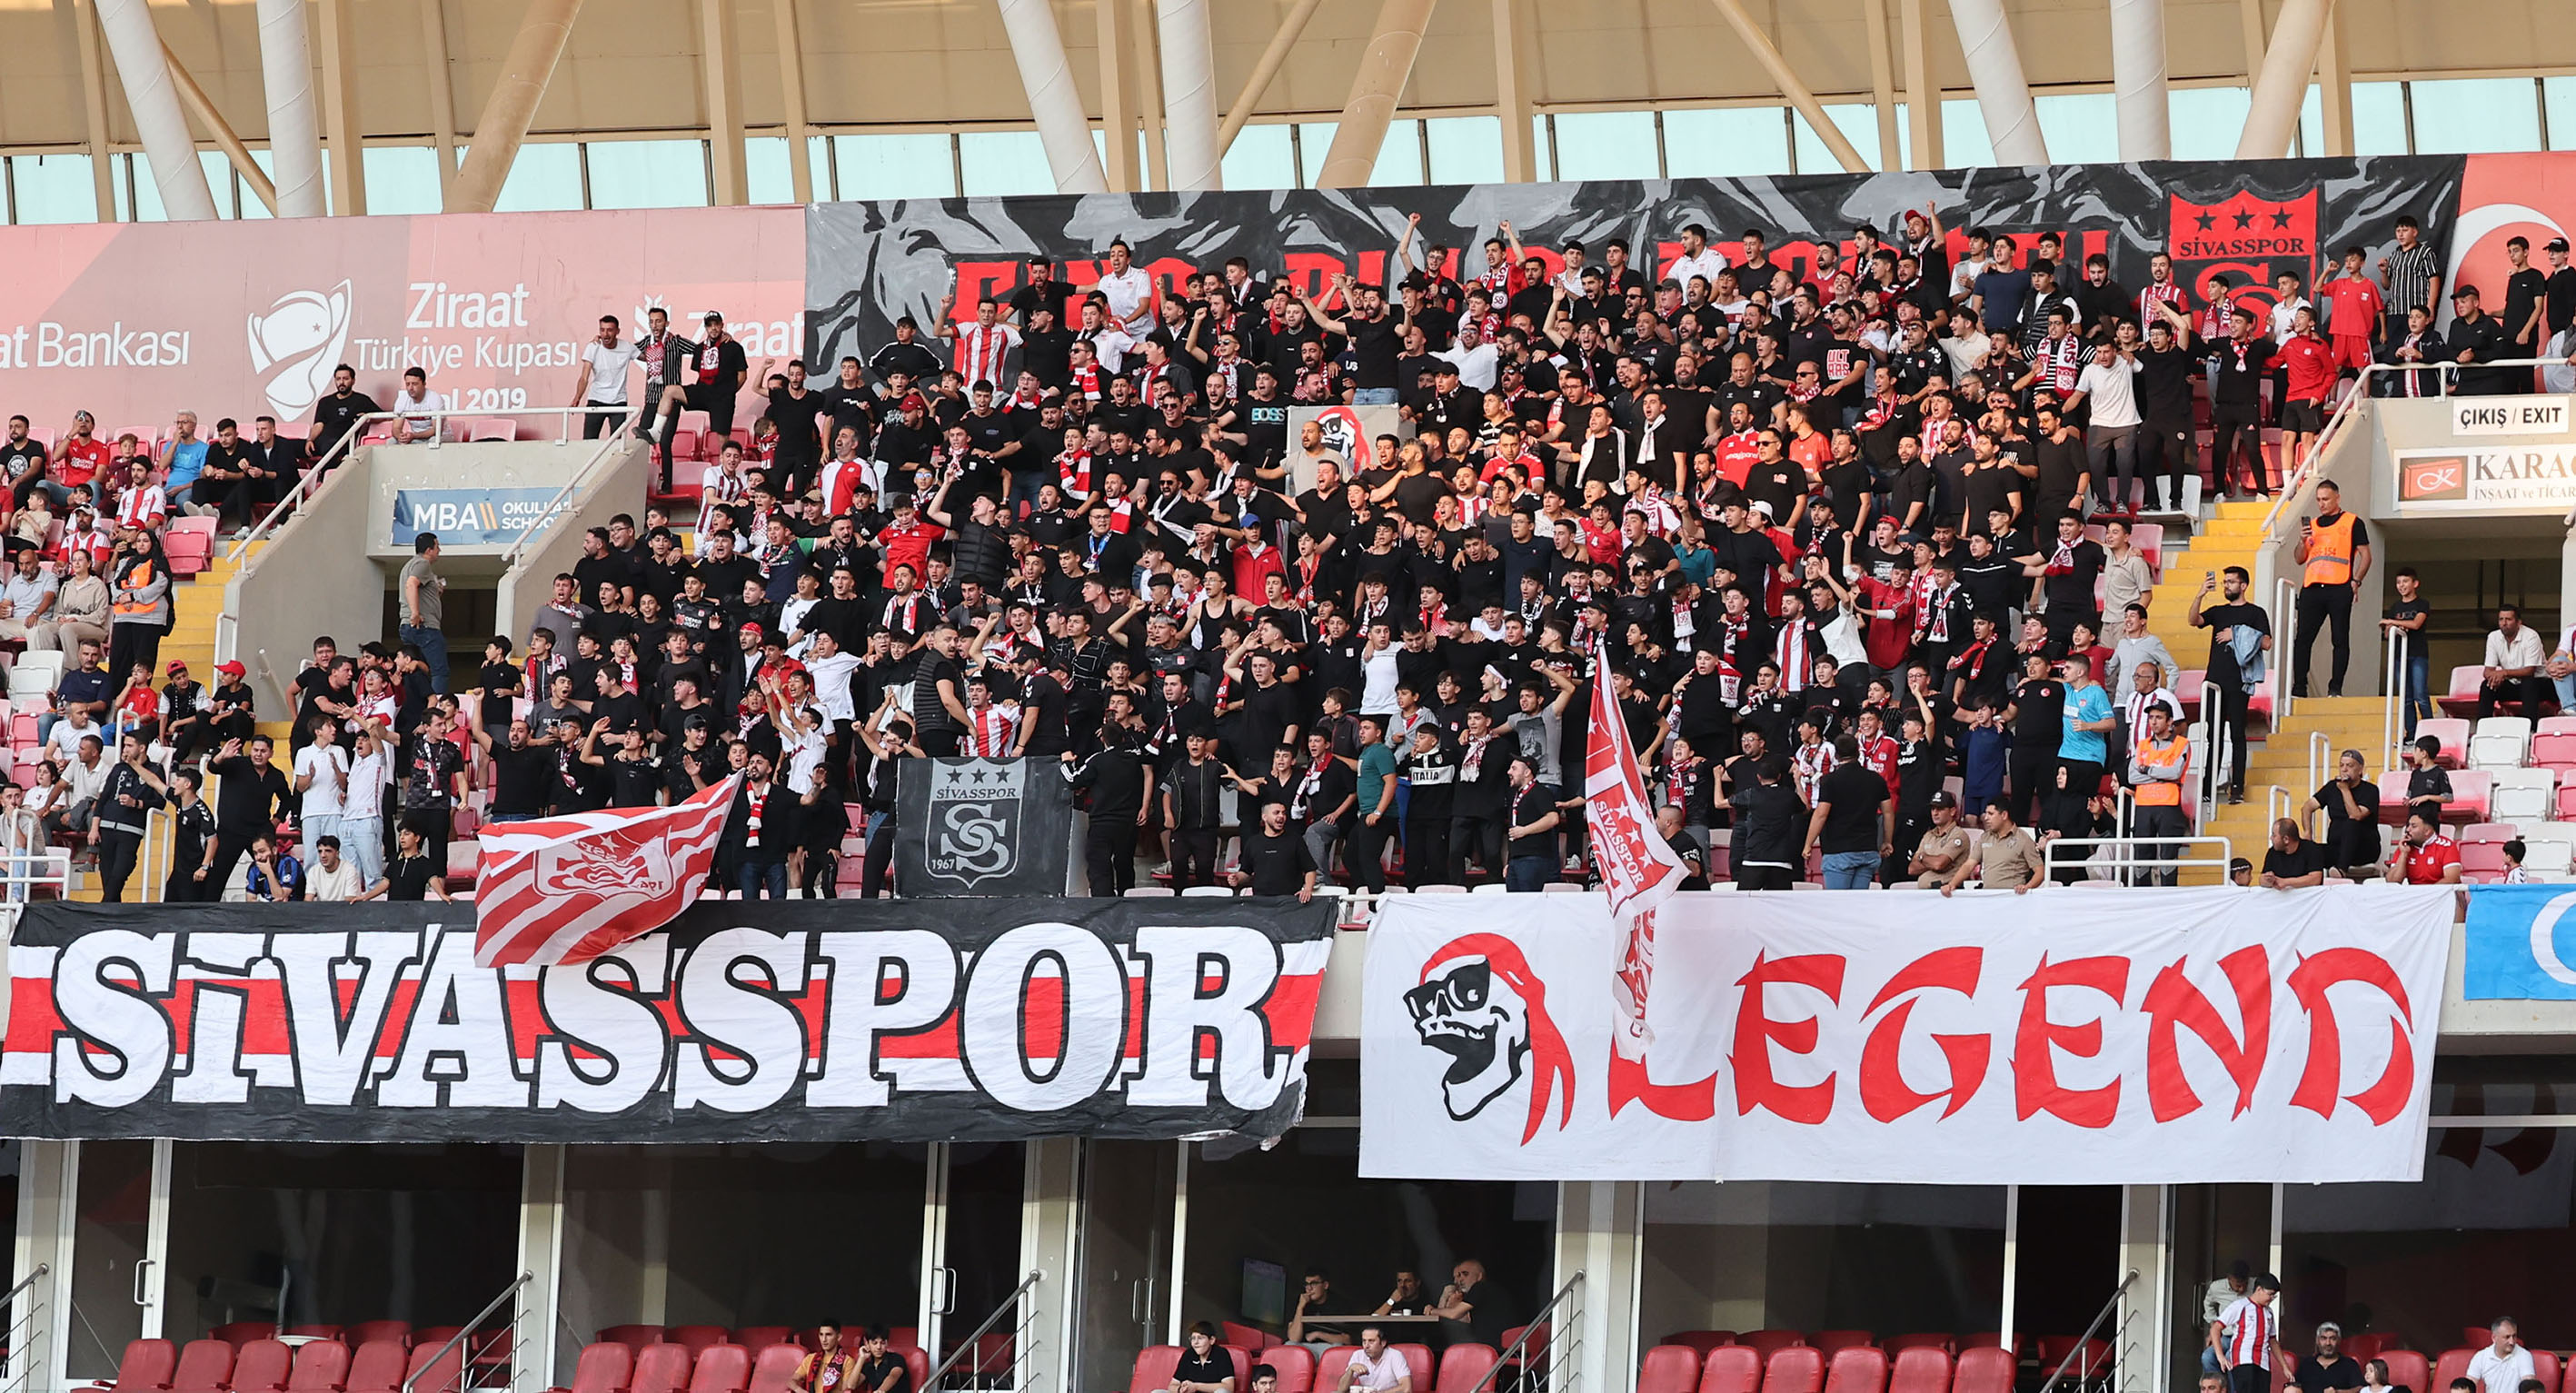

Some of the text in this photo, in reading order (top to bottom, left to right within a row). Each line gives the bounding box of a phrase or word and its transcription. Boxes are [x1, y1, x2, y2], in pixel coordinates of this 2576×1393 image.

[2180, 237, 2304, 256] SİVASSPOR
[406, 283, 530, 328] Ziraat
[37, 322, 190, 367] Bankası
[687, 311, 805, 358] Zraat
[354, 335, 577, 377] Türkiye Kupası
[1827, 349, 1850, 363] ULT
[466, 387, 527, 411] 2019
[1251, 407, 1286, 423] BOSS
[2461, 408, 2508, 429] ÇIKIŞ
[2522, 407, 2562, 424] EXIT
[2474, 486, 2521, 502] İNŞAAT
[2523, 489, 2534, 499] ve
[413, 502, 480, 532] MBA
[1591, 535, 1598, 546] 4
[1413, 771, 1439, 781] ITALIA
[937, 785, 1017, 800] SİVASSPOR
[1596, 798, 1645, 886] SİVASSPOR
[931, 858, 955, 870] 1967
[54, 923, 1293, 1112] SİVASSPOR
[1607, 943, 2414, 1128] LEGEND
